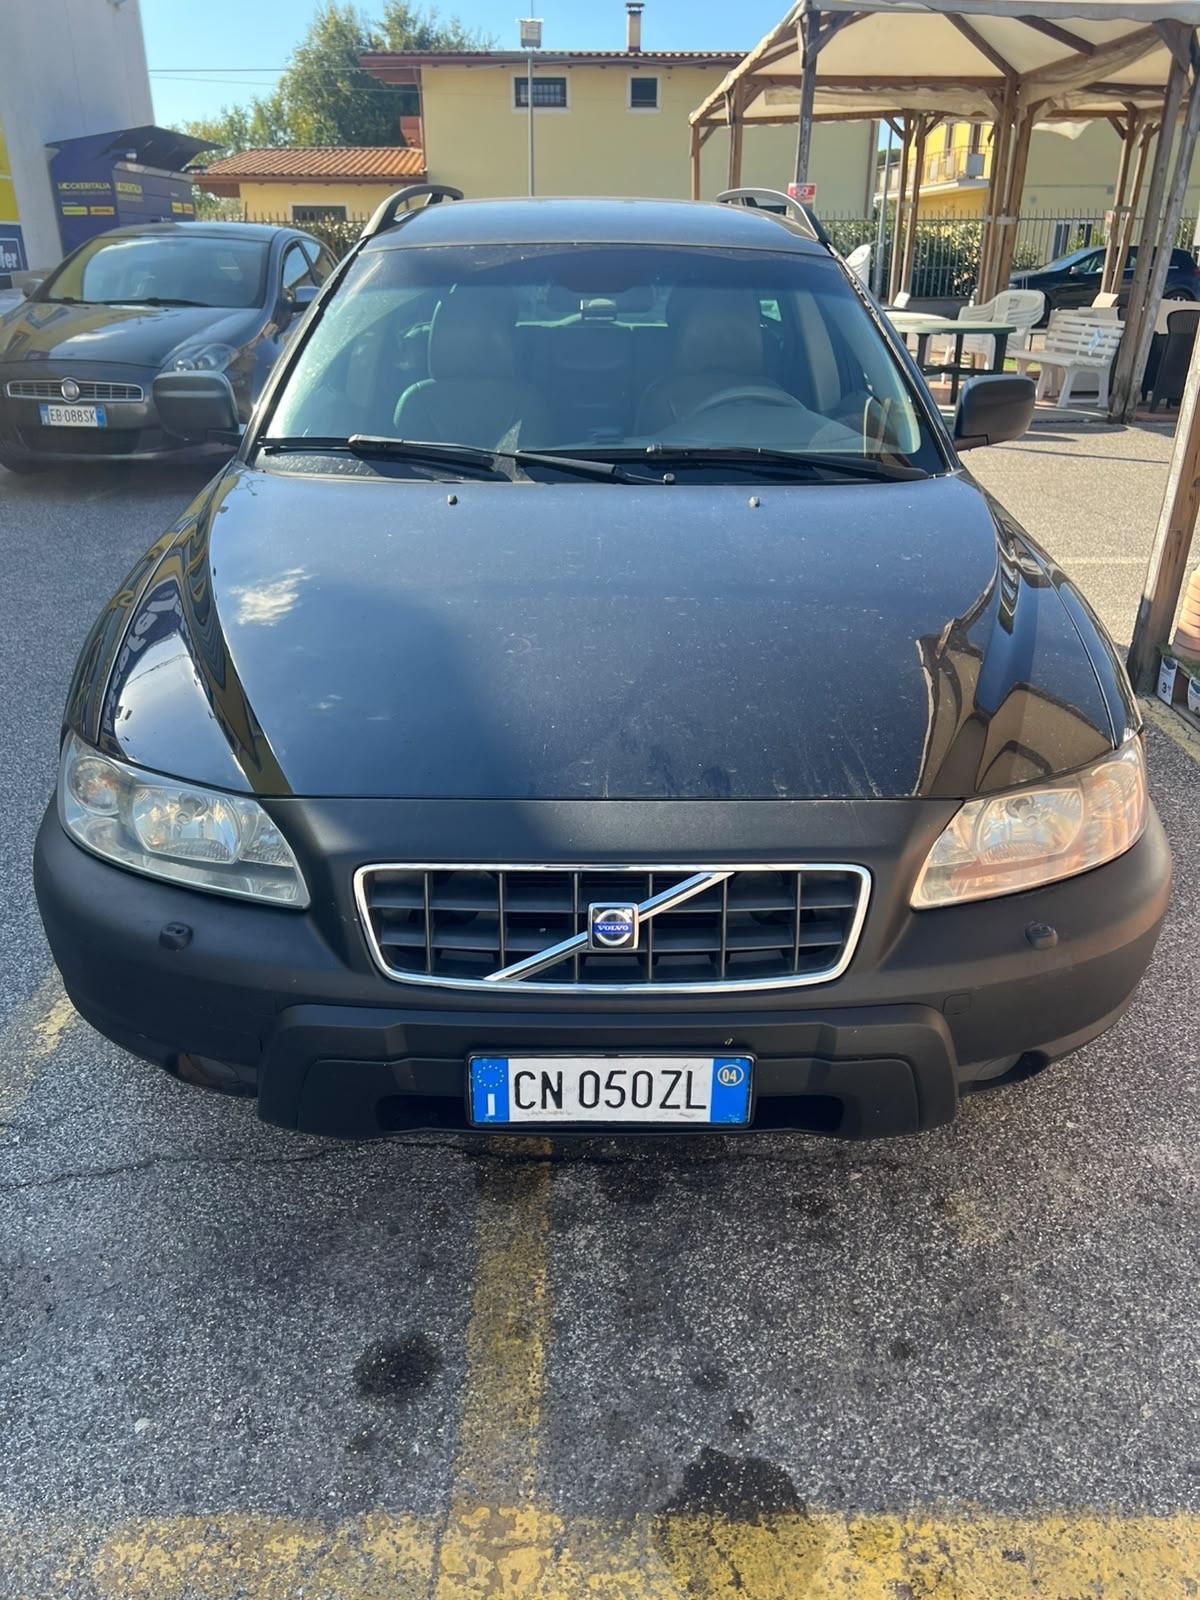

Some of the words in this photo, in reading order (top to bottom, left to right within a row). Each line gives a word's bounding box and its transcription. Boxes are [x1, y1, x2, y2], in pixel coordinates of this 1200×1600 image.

[50, 408, 62, 422] EB
[64, 409, 96, 423] 088SK
[722, 1069, 737, 1082] 04
[514, 1070, 563, 1110] CN
[578, 1070, 707, 1110] 050ZL
